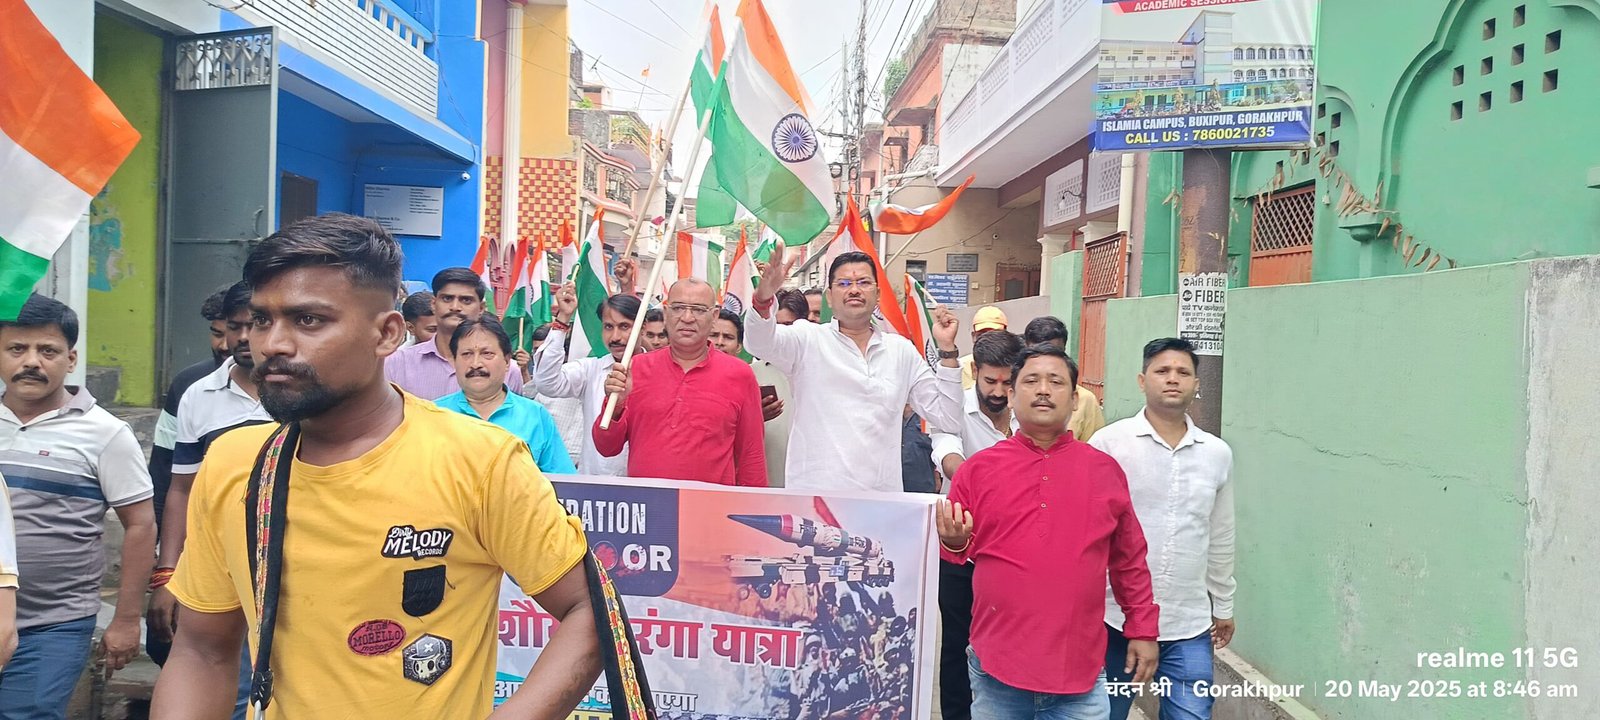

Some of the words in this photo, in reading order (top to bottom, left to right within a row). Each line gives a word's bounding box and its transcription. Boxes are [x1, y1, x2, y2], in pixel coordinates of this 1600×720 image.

[1134, 0, 1188, 11] ACADEMIC
[1102, 119, 1142, 132] ISLAMIA
[1143, 116, 1187, 130] CAMPUS,
[1188, 113, 1236, 128] BUXIPUR,
[1237, 110, 1303, 125] GORAKHPUR
[1125, 131, 1159, 144] CALL
[1162, 130, 1181, 142] US
[1192, 126, 1275, 141] 7860021735
[1194, 290, 1225, 303] FIBER
[383, 530, 452, 556] MELODY
[416, 548, 443, 557] RECORDS
[352, 630, 401, 647] MORELLO
[711, 623, 802, 668] यात्रा
